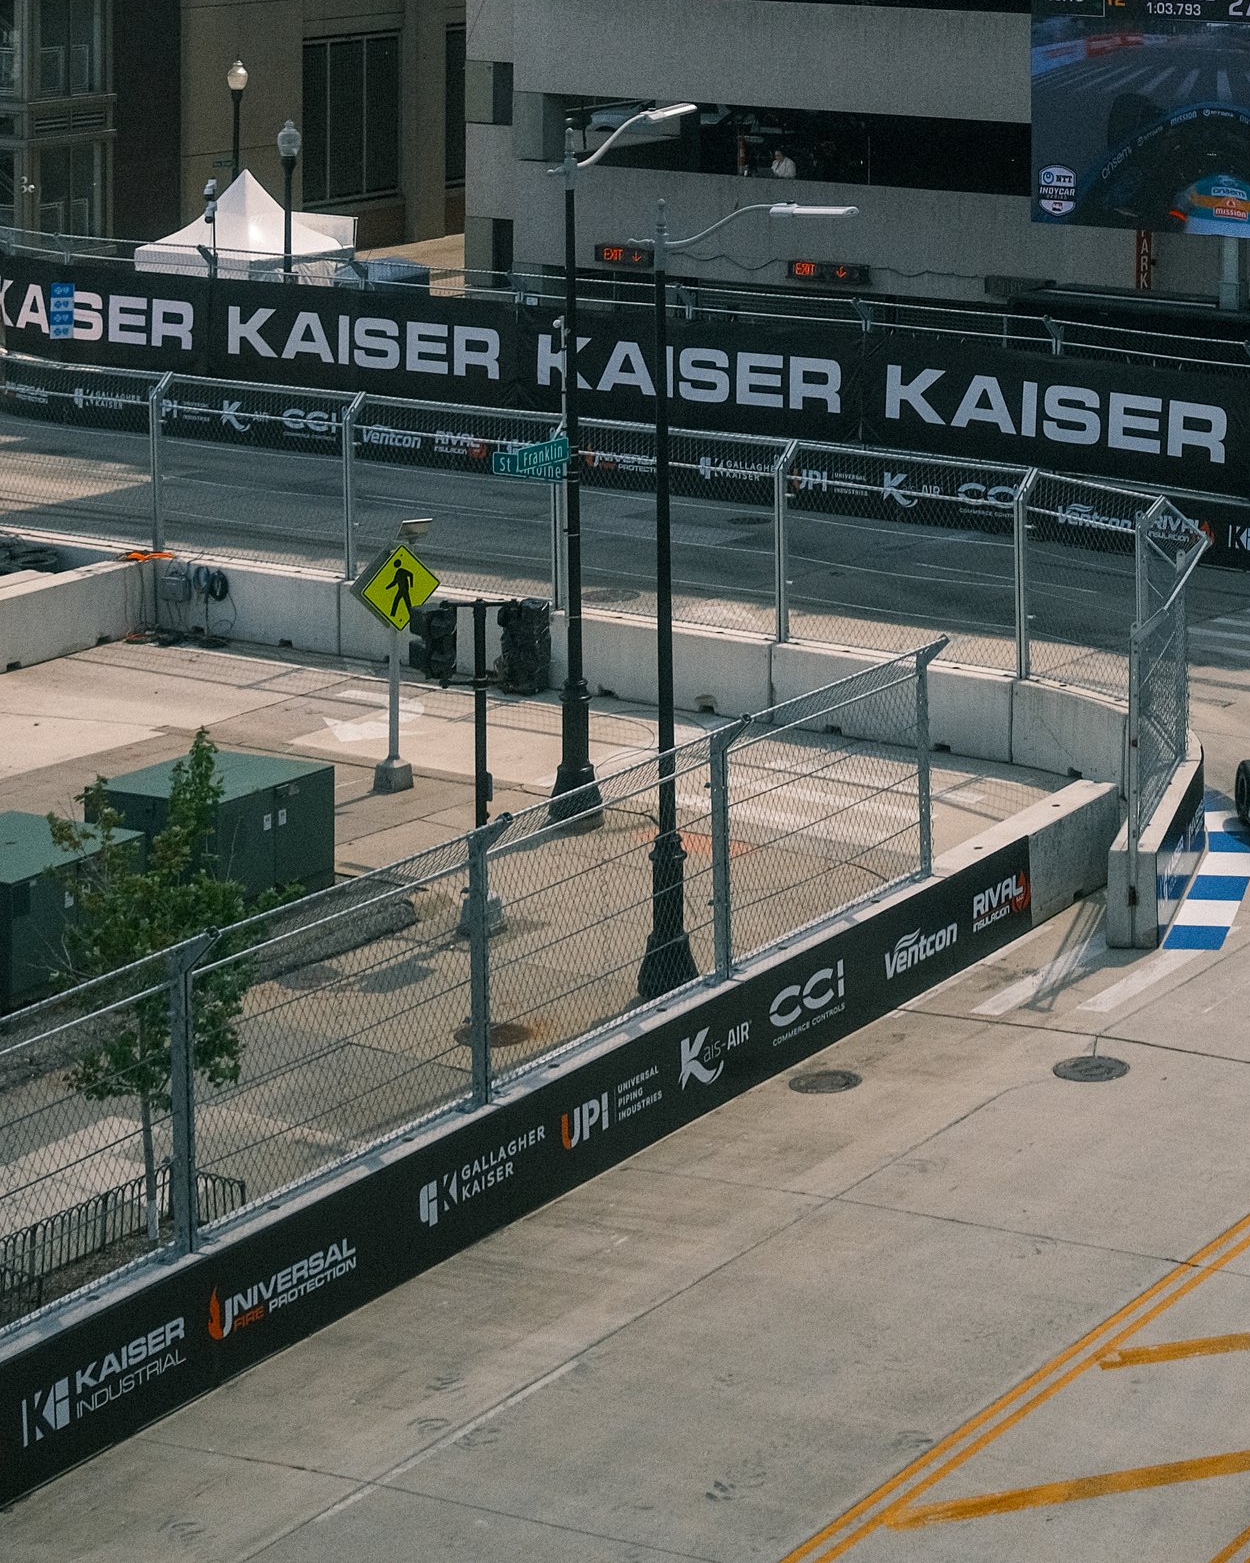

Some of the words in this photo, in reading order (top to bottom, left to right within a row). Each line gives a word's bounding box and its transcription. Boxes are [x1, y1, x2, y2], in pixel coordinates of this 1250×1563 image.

[1146, 2, 1201, 16] 1:03.793
[1040, 187, 1075, 196] INDYCAR
[603, 247, 624, 261] EXIT
[795, 262, 816, 276] EXIT
[0, 279, 194, 350] ASER
[227, 306, 500, 379] KAISER
[161, 398, 178, 419] PI
[884, 364, 1227, 464] KAISER
[500, 457, 511, 472] St
[523, 443, 563, 467] Franklin
[726, 459, 775, 473] GALLAGHE
[973, 875, 1023, 918] RIVAL
[885, 923, 957, 980] Ventcon
[769, 959, 845, 1027] CCI
[773, 1021, 810, 1046] COMMERCE
[812, 1003, 846, 1026] CONTROLS
[618, 1066, 659, 1094] UNIVERSAL
[618, 1088, 643, 1107] PIPING
[561, 1092, 608, 1149] UPI
[618, 1090, 662, 1121] INDUSTRIES
[462, 1125, 545, 1180] GALLAGHER
[462, 1162, 514, 1201] KAISER
[234, 1305, 264, 1332] FIRE
[269, 1257, 356, 1314] PROTECTION
[76, 1317, 185, 1394] KAISER
[77, 1349, 187, 1419] INDUSTRIAL
